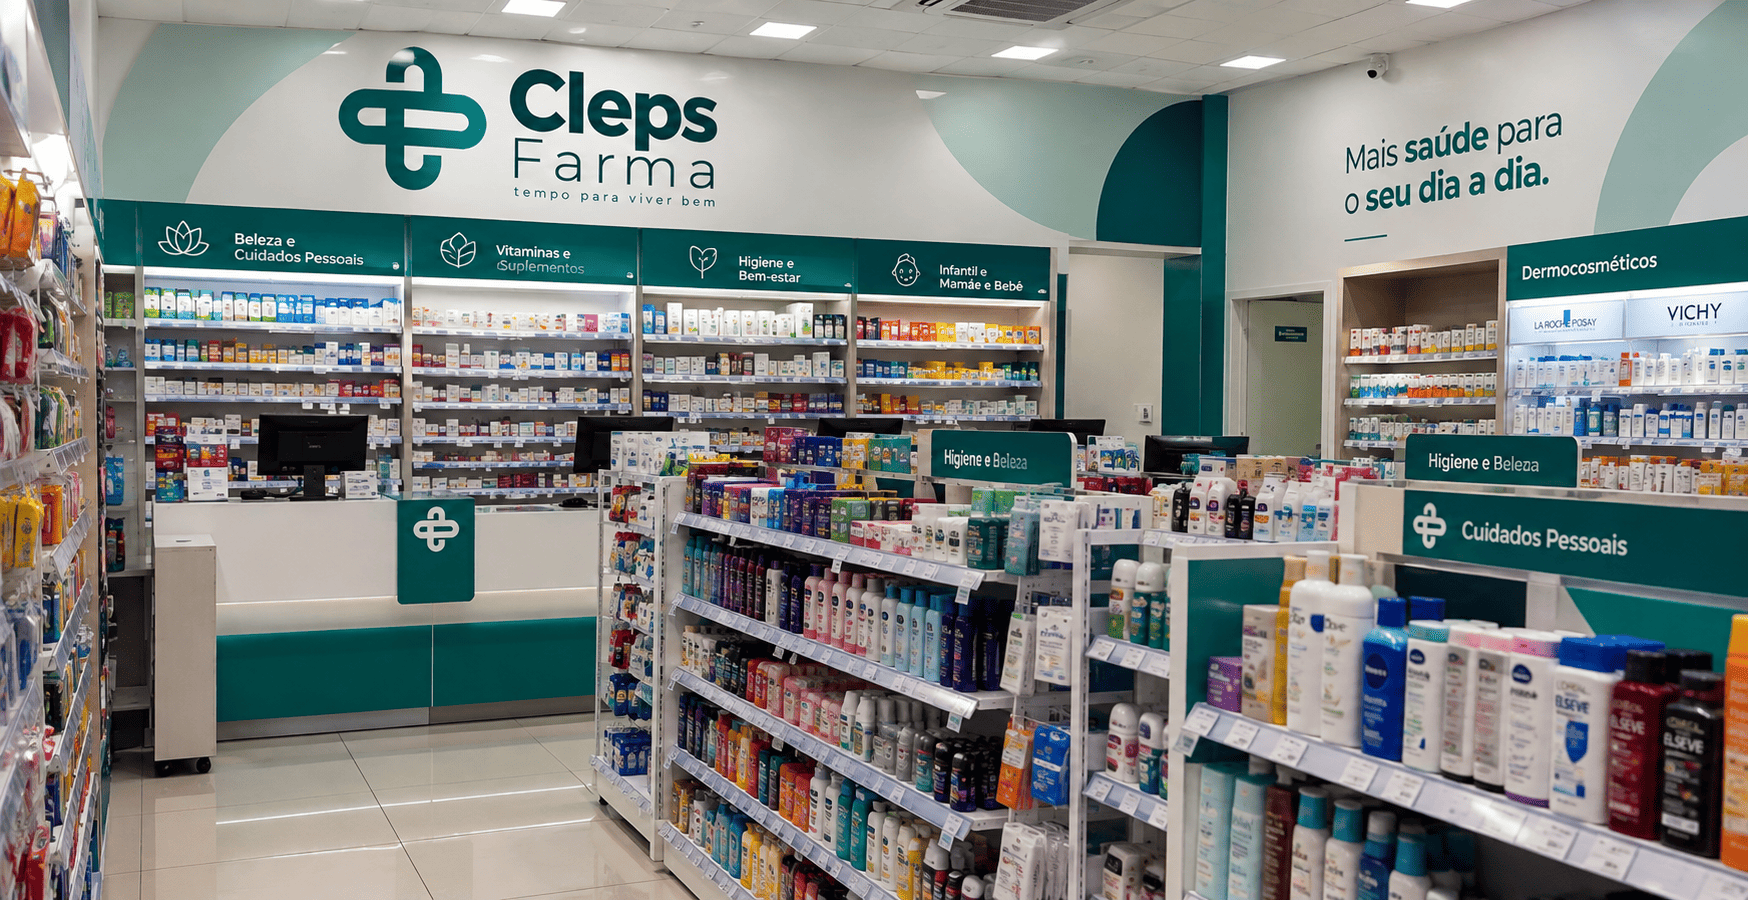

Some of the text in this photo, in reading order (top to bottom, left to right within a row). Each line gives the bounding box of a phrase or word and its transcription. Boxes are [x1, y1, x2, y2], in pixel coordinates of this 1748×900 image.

[510, 69, 717, 151] Cleps
[1346, 112, 1562, 174] Mais saúde para
[514, 138, 715, 189] Farma
[1345, 155, 1549, 214] o seu dia a dia.
[514, 187, 716, 208] tempo para viver bem
[234, 232, 296, 247] Beleza e
[234, 248, 364, 266] Cuidados Pessoais
[496, 244, 571, 260] Vitaminas e
[497, 260, 585, 276] Suplementos
[738, 255, 795, 271] Higiene e
[939, 264, 988, 277] Infantil e
[1522, 253, 1658, 281] Dermocosméticos
[739, 269, 801, 284] Bem-estar
[984, 282, 992, 290] e
[994, 280, 1024, 292] Bebé
[1667, 302, 1722, 321] VICHY
[1534, 321, 1544, 330] LA
[1572, 317, 1598, 328] POSAY
[944, 449, 1028, 471] Higiene e Beleza
[1428, 453, 1479, 473] Higiene
[1482, 459, 1490, 471] e
[1461, 520, 1628, 557] Cuidados Pessoais
[1555, 694, 1590, 714] ELSEVE
[1663, 731, 1705, 755] ELSEVE
